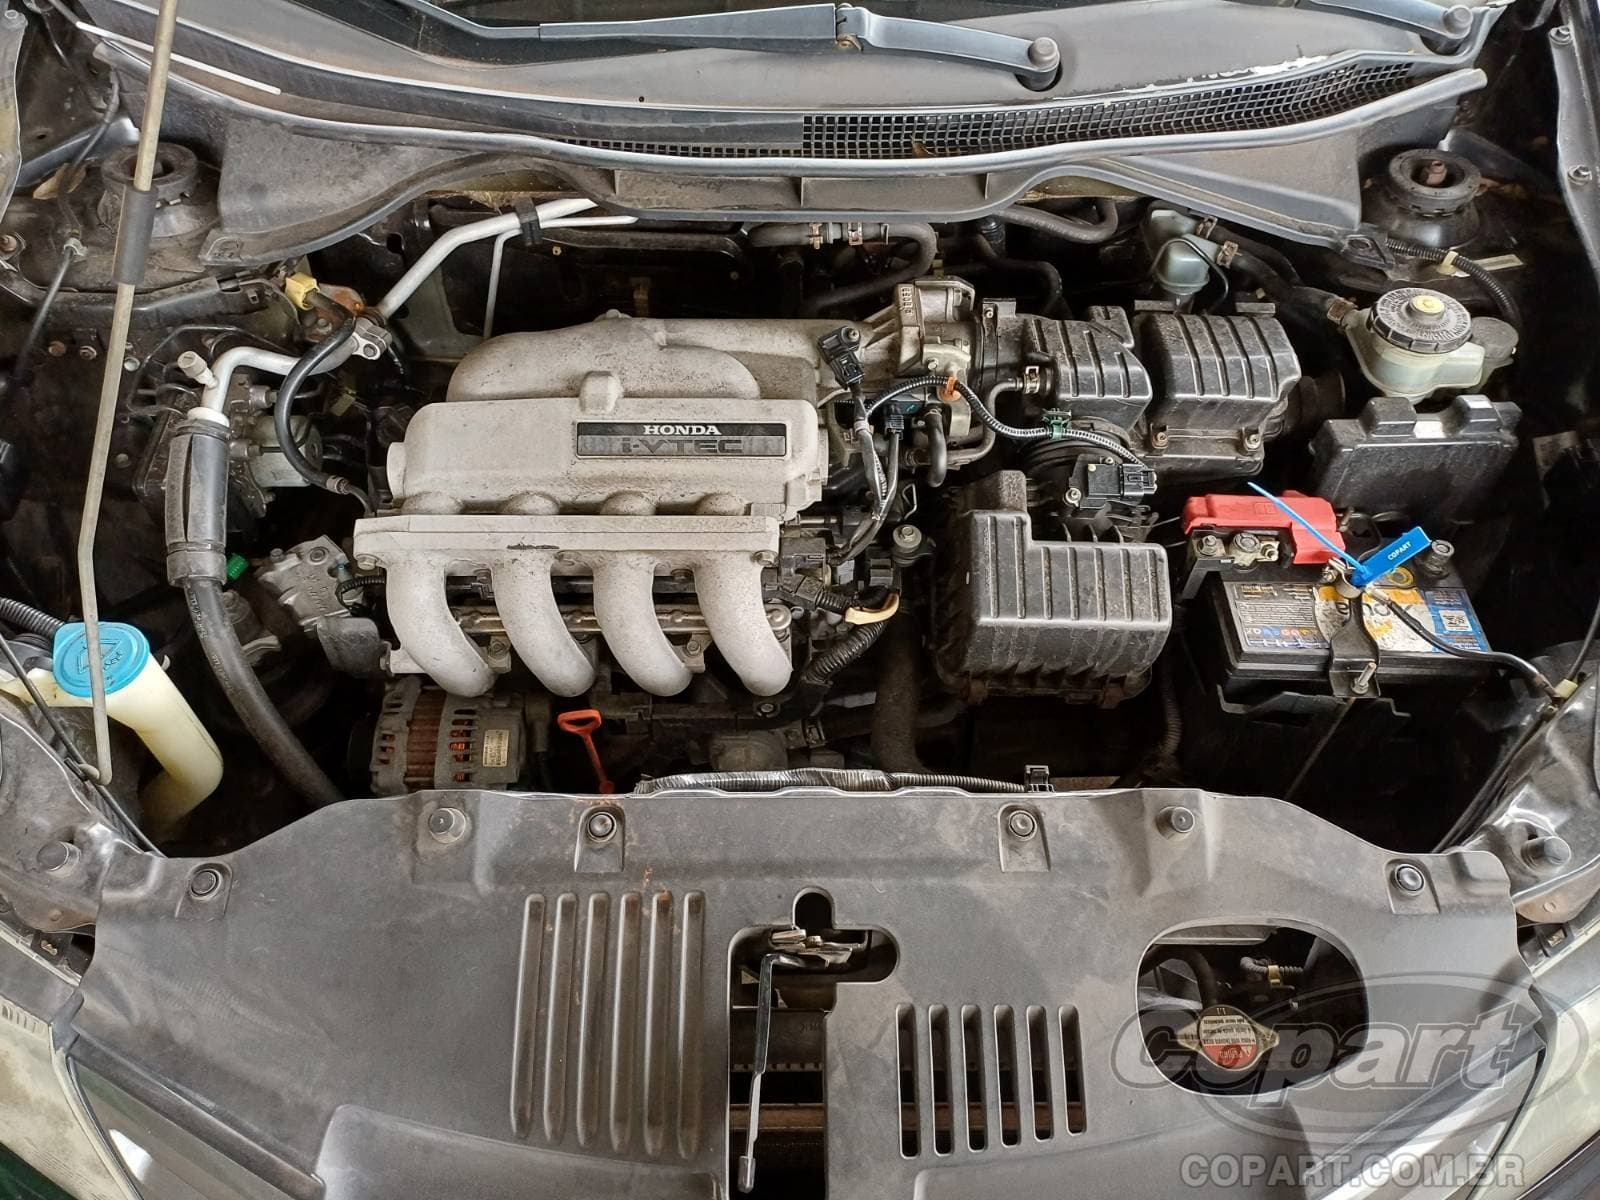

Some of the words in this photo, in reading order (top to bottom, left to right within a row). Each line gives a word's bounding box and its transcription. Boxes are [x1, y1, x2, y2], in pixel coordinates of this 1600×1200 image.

[643, 424, 722, 436] HONDA
[621, 437, 742, 454] i-VTEC
[1387, 541, 1412, 560] COPART
